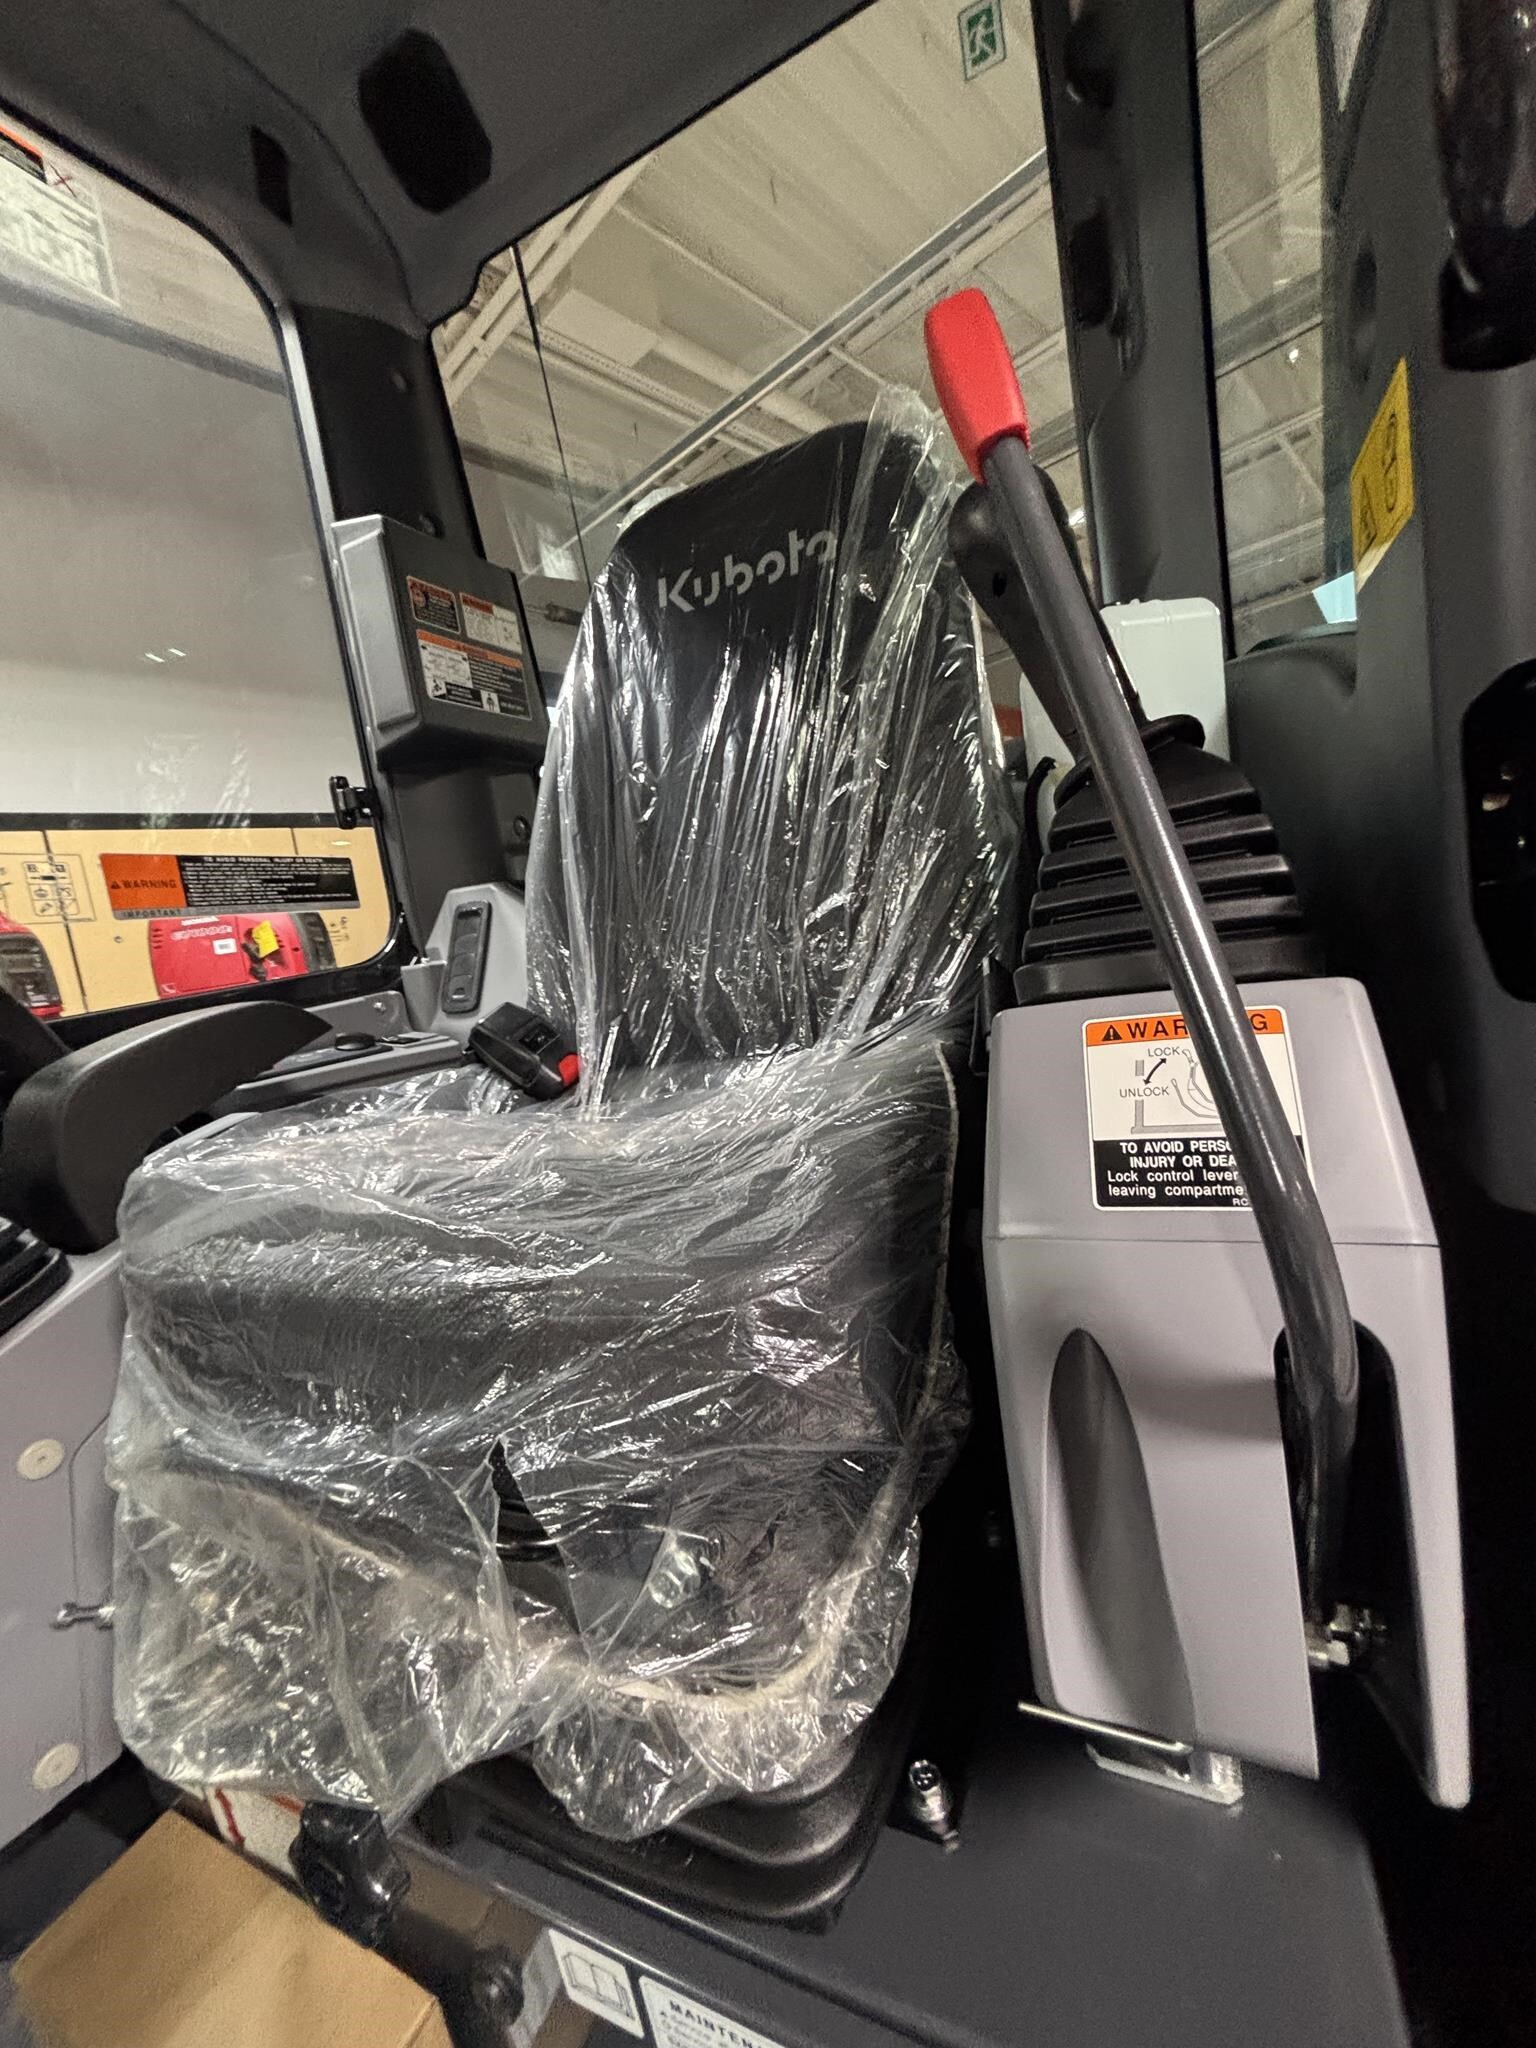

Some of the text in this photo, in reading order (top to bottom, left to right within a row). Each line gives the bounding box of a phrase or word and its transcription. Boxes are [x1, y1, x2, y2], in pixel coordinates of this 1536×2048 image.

[657, 529, 838, 613] Kubota
[123, 879, 178, 889] WARNING
[123, 908, 182, 919] IMPORTANT
[1127, 1013, 1268, 1040] WARG
[1147, 1046, 1180, 1058] LOCK
[1119, 1086, 1170, 1098] UNLOCK
[1120, 1142, 1138, 1154] TO
[1143, 1141, 1184, 1153] AVOID
[1130, 1155, 1175, 1168] INJURY
[1182, 1155, 1203, 1168] OR
[1107, 1169, 1239, 1182] Lock control lever
[1108, 1184, 1156, 1198] leaving
[669, 2000, 763, 2048] MAINTEN
